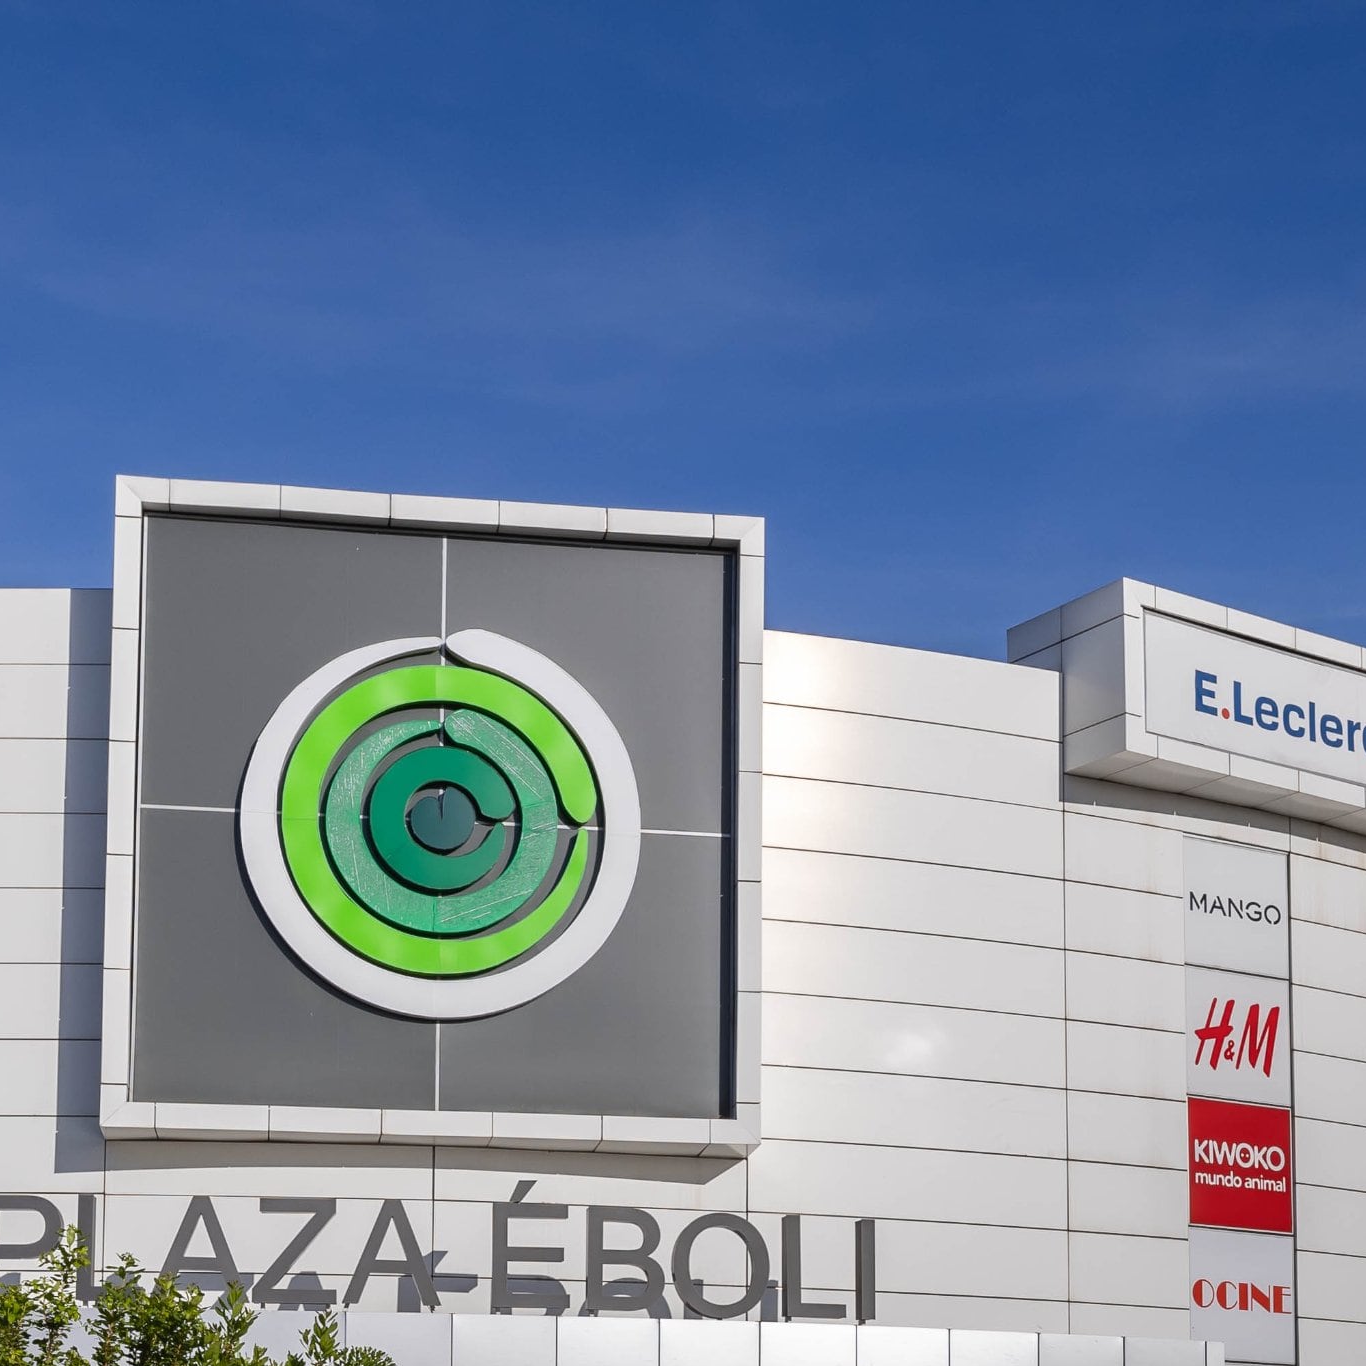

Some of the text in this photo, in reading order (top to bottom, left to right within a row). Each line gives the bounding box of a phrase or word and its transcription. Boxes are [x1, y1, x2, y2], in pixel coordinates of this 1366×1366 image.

[1189, 891, 1282, 925] MANGO
[1195, 997, 1280, 1078] H&M
[1194, 1139, 1285, 1172] KIWOKO
[1195, 1171, 1287, 1193] mundo animal
[491, 1180, 876, 1321] ÉBOLI
[1192, 1278, 1292, 1315] OCINE
